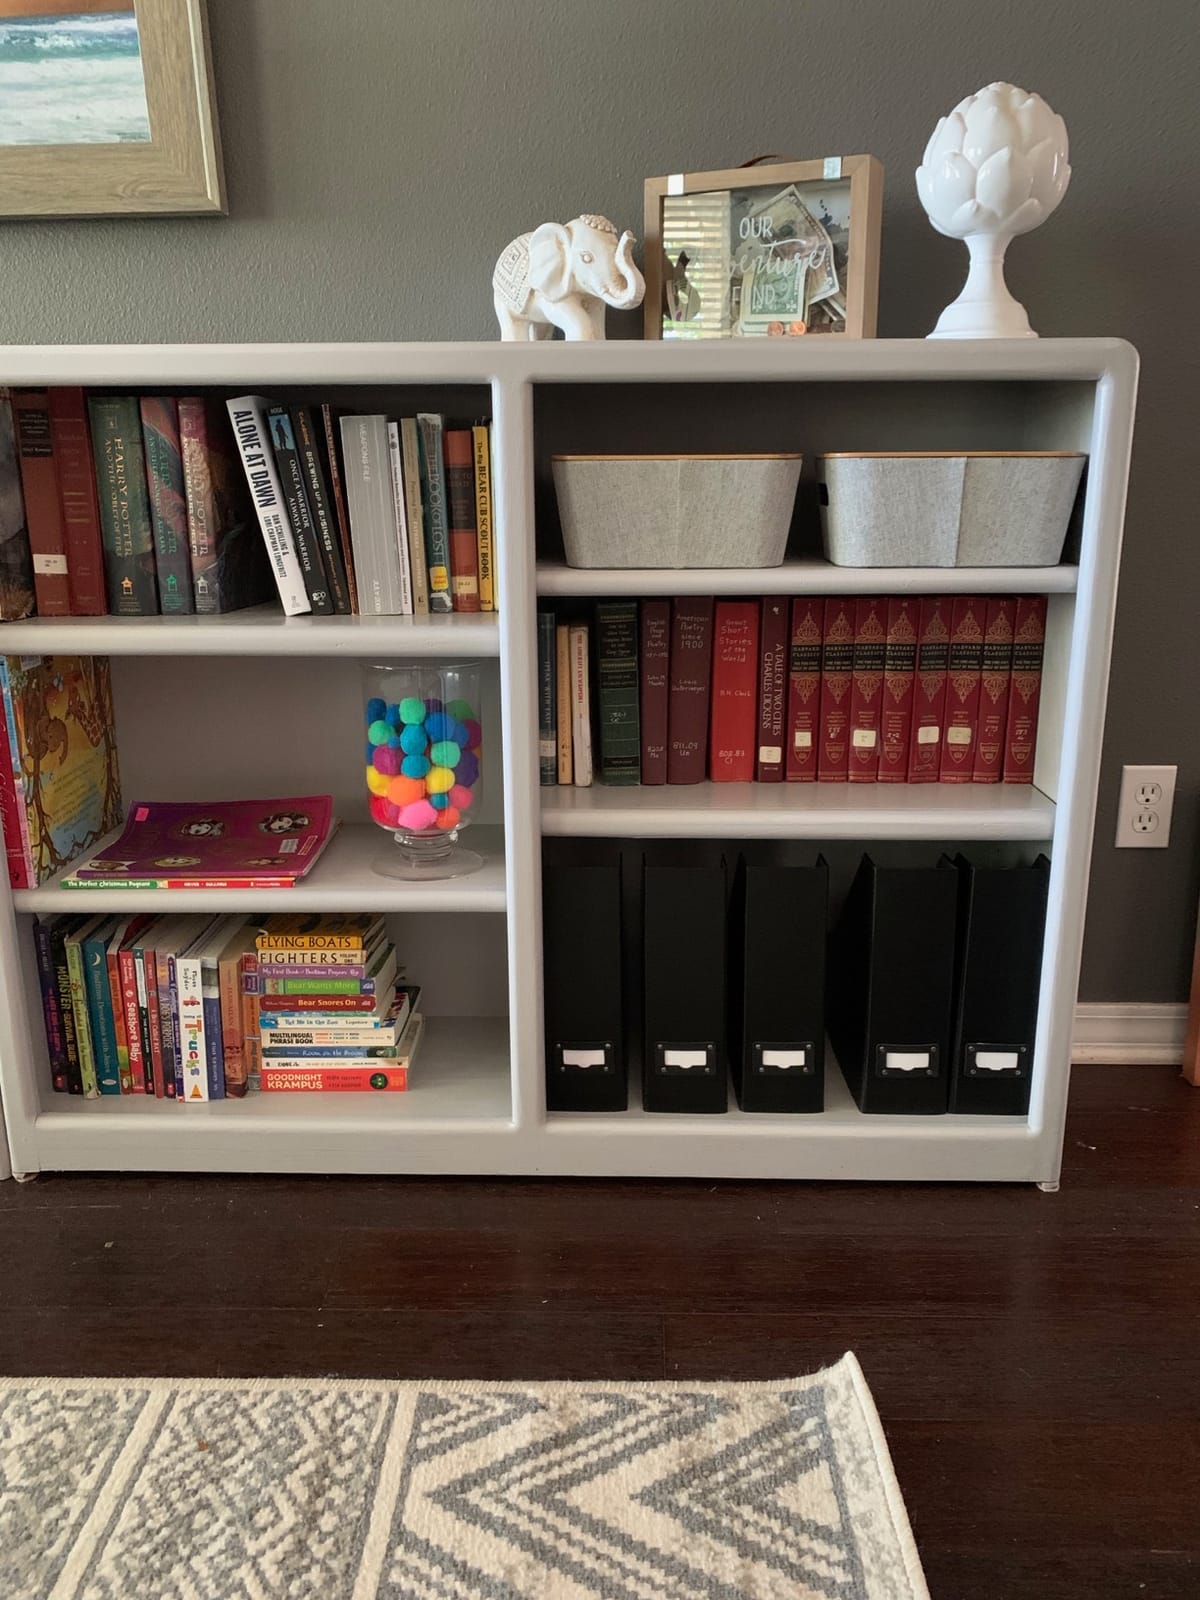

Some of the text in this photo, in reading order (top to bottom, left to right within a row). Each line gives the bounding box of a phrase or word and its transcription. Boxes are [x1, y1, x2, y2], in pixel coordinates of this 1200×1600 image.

[740, 216, 773, 240] OUR
[233, 410, 277, 509] ALONE AT DAWN
[359, 423, 371, 481] WEAPONS FILE
[306, 451, 319, 489] BREWING
[478, 465, 487, 494] BEAR
[114, 438, 133, 557] HARRY POTTER
[289, 459, 299, 483] ONCE
[295, 490, 310, 529] WARRIOR
[314, 491, 321, 501] UP
[429, 473, 442, 511] BOOK
[479, 495, 488, 516] CUB
[195, 500, 209, 556] POTTER
[263, 515, 272, 527] LORI
[272, 514, 282, 525] DAN
[317, 510, 333, 551] BUSINESS
[266, 528, 279, 551] CHAPMAN
[274, 525, 288, 550] SCHILLING
[288, 497, 300, 527] ALWAYS
[297, 535, 311, 571] WARRIOR
[431, 525, 445, 556] LOST
[479, 517, 488, 552] SCOUT
[480, 552, 490, 580] BOOK
[681, 640, 704, 649] 1900
[775, 653, 784, 672] TALE
[762, 652, 773, 729] CHARLES DICKENS
[775, 672, 784, 685] OF
[774, 688, 783, 710] TWO
[773, 711, 782, 736] CITIES
[261, 936, 352, 948] FLYING BOATS
[260, 953, 338, 964] FIGHTERS
[55, 966, 72, 1010] MONSTER
[96, 1001, 106, 1036] Devotions
[101, 1037, 109, 1052] with
[127, 1002, 142, 1062] Seashore Baby
[185, 1020, 202, 1076] Trucks
[267, 1073, 322, 1081] GOODNIGHT
[267, 1081, 323, 1089] KRAMPUS
